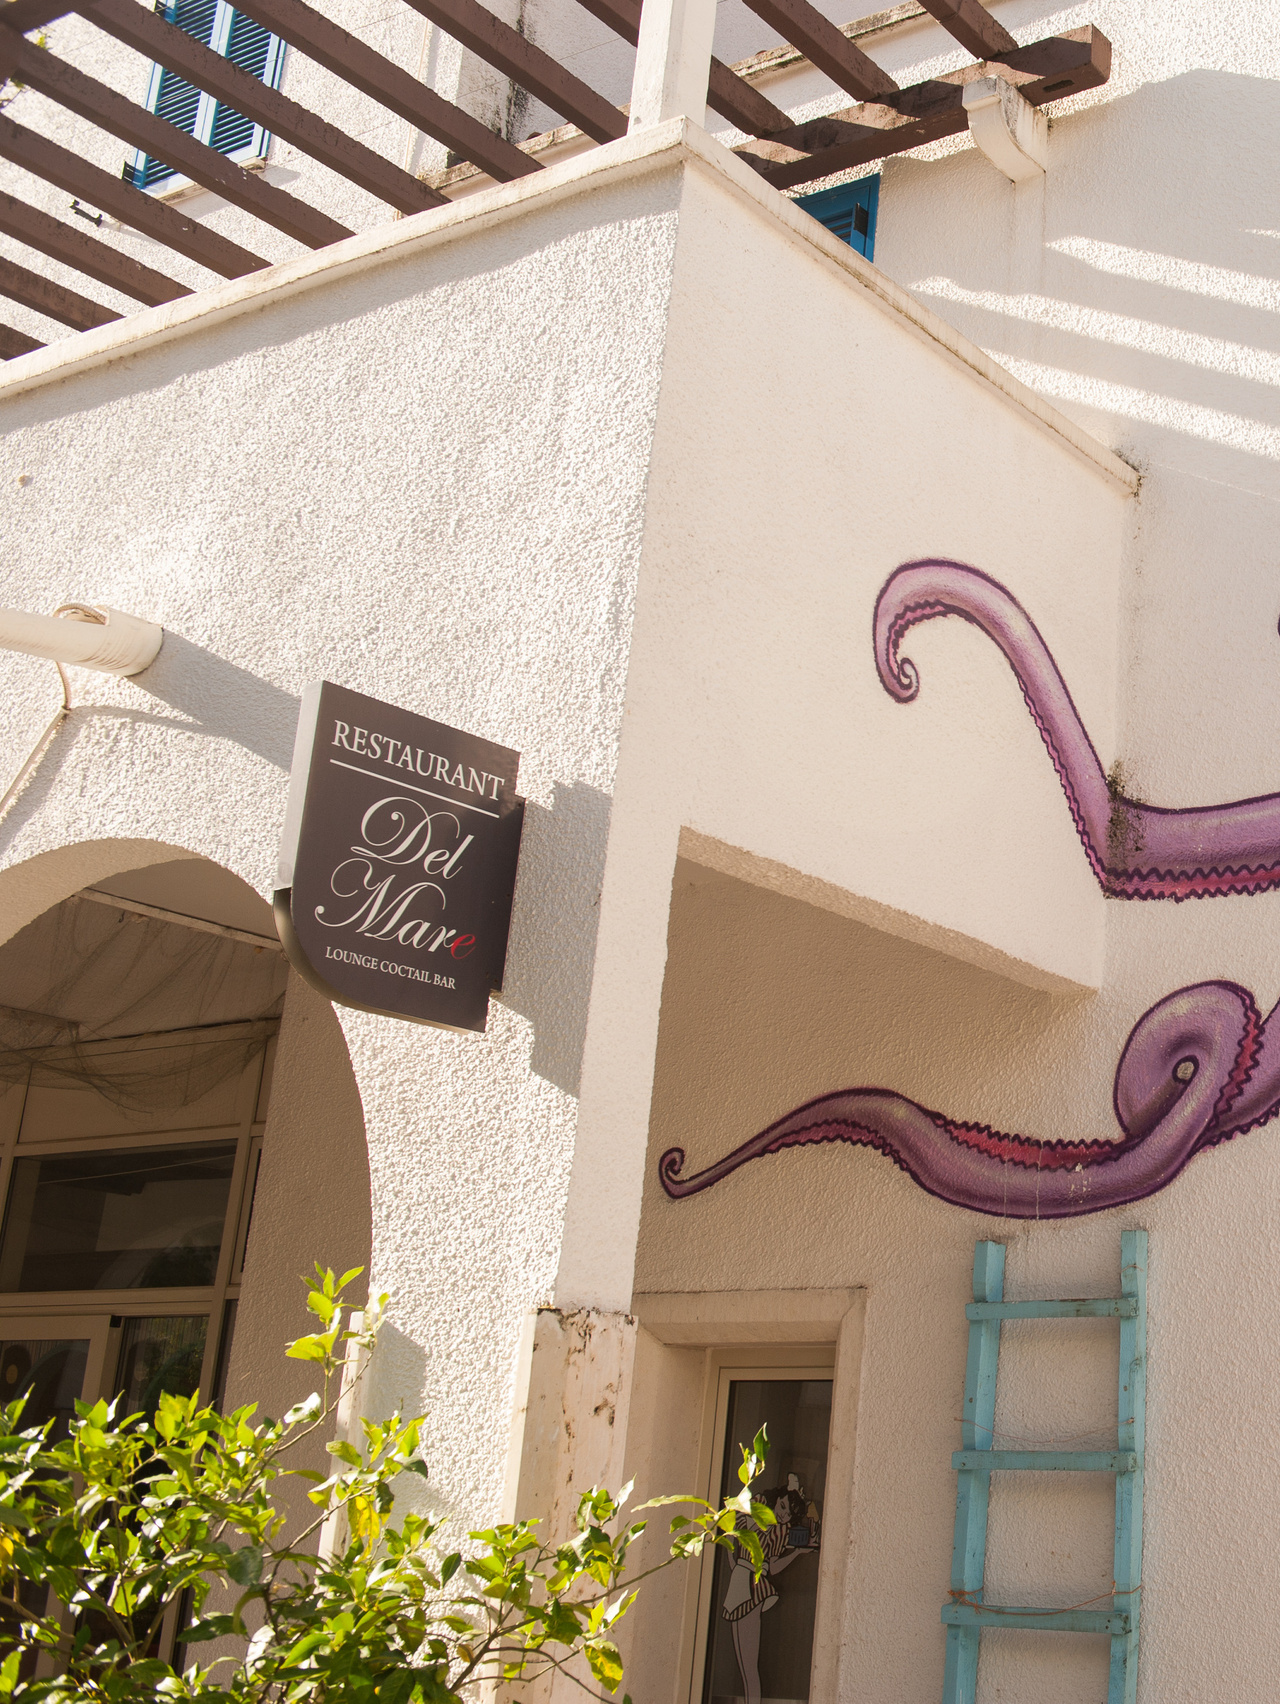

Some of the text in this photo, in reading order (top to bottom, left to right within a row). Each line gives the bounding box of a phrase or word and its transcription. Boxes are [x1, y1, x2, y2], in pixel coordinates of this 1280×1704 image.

[332, 720, 505, 801] RESTAURANT
[351, 797, 475, 879] Del
[315, 858, 476, 958] Mare
[325, 946, 456, 990] LOUNGE COCTAIL BAR
